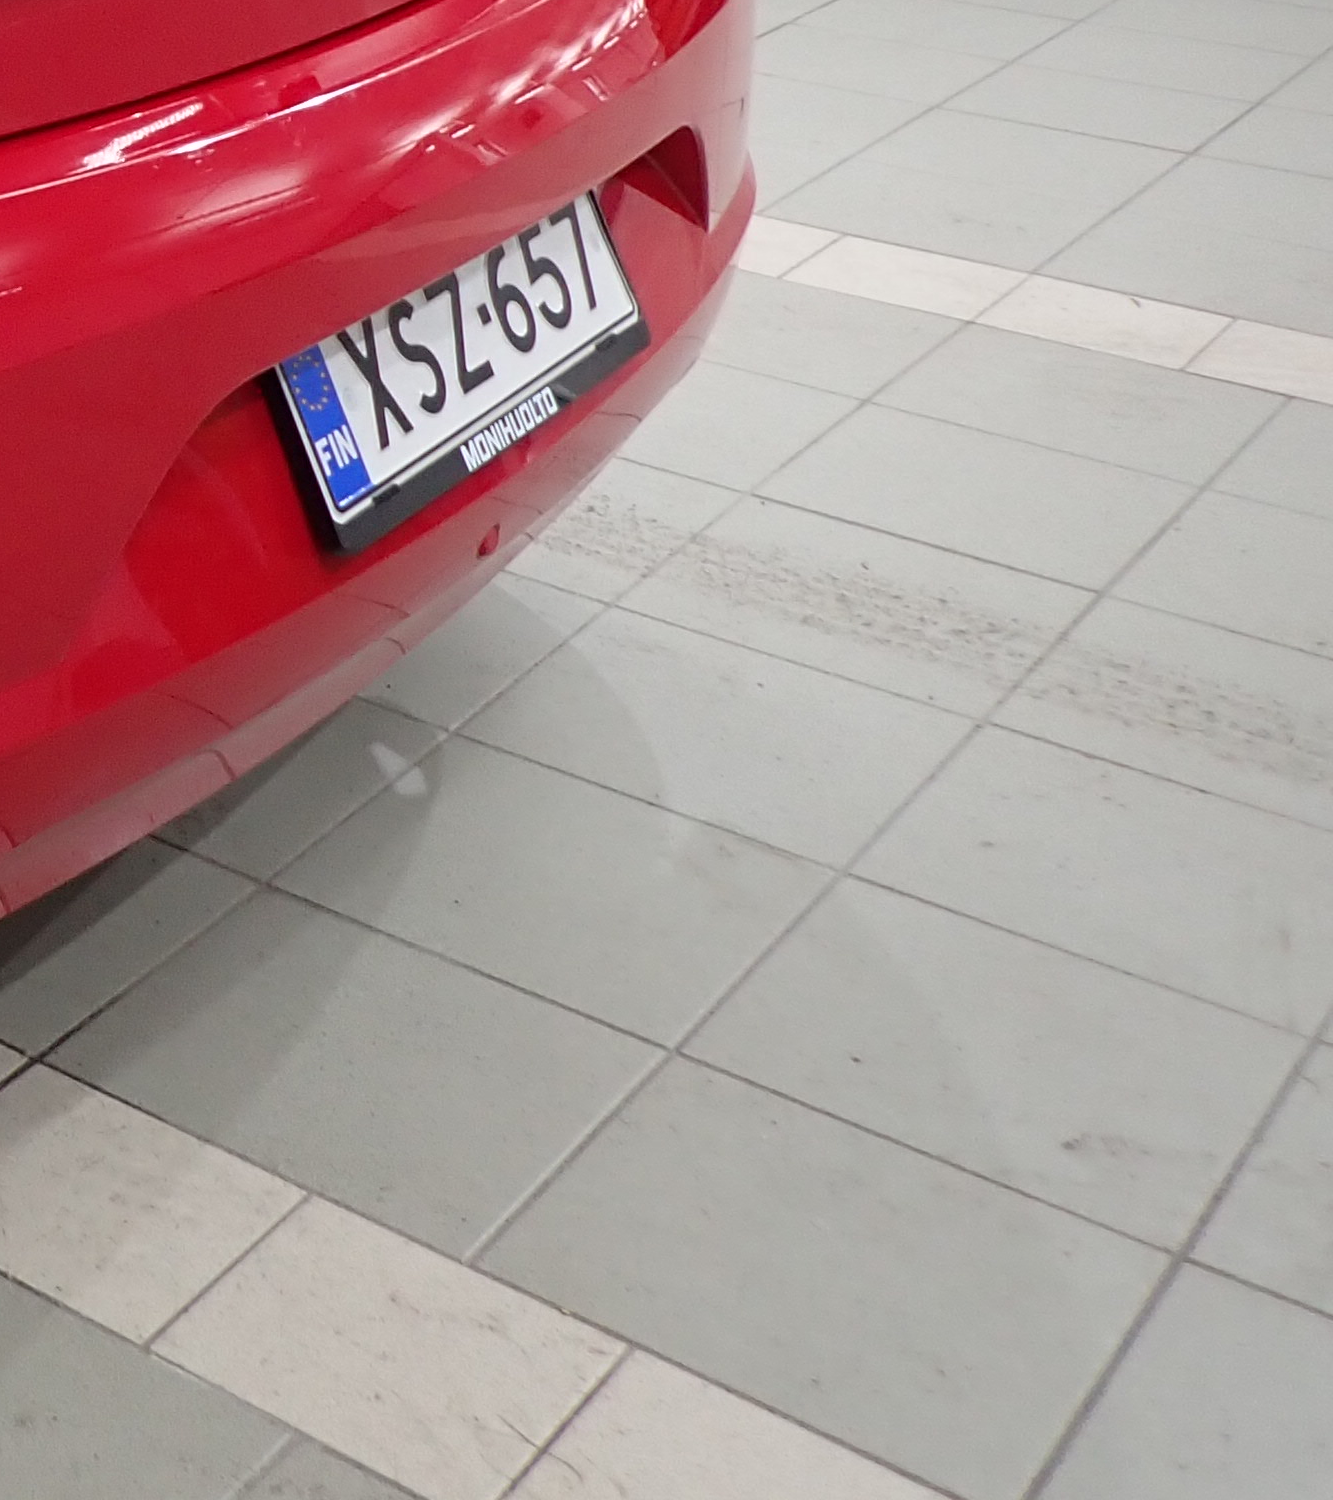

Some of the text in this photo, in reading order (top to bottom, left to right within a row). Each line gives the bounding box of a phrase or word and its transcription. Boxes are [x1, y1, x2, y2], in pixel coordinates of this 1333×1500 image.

[336, 199, 598, 451] XSZ-657
[315, 424, 359, 477] FIN
[459, 385, 559, 473] MONIHUOLTO
